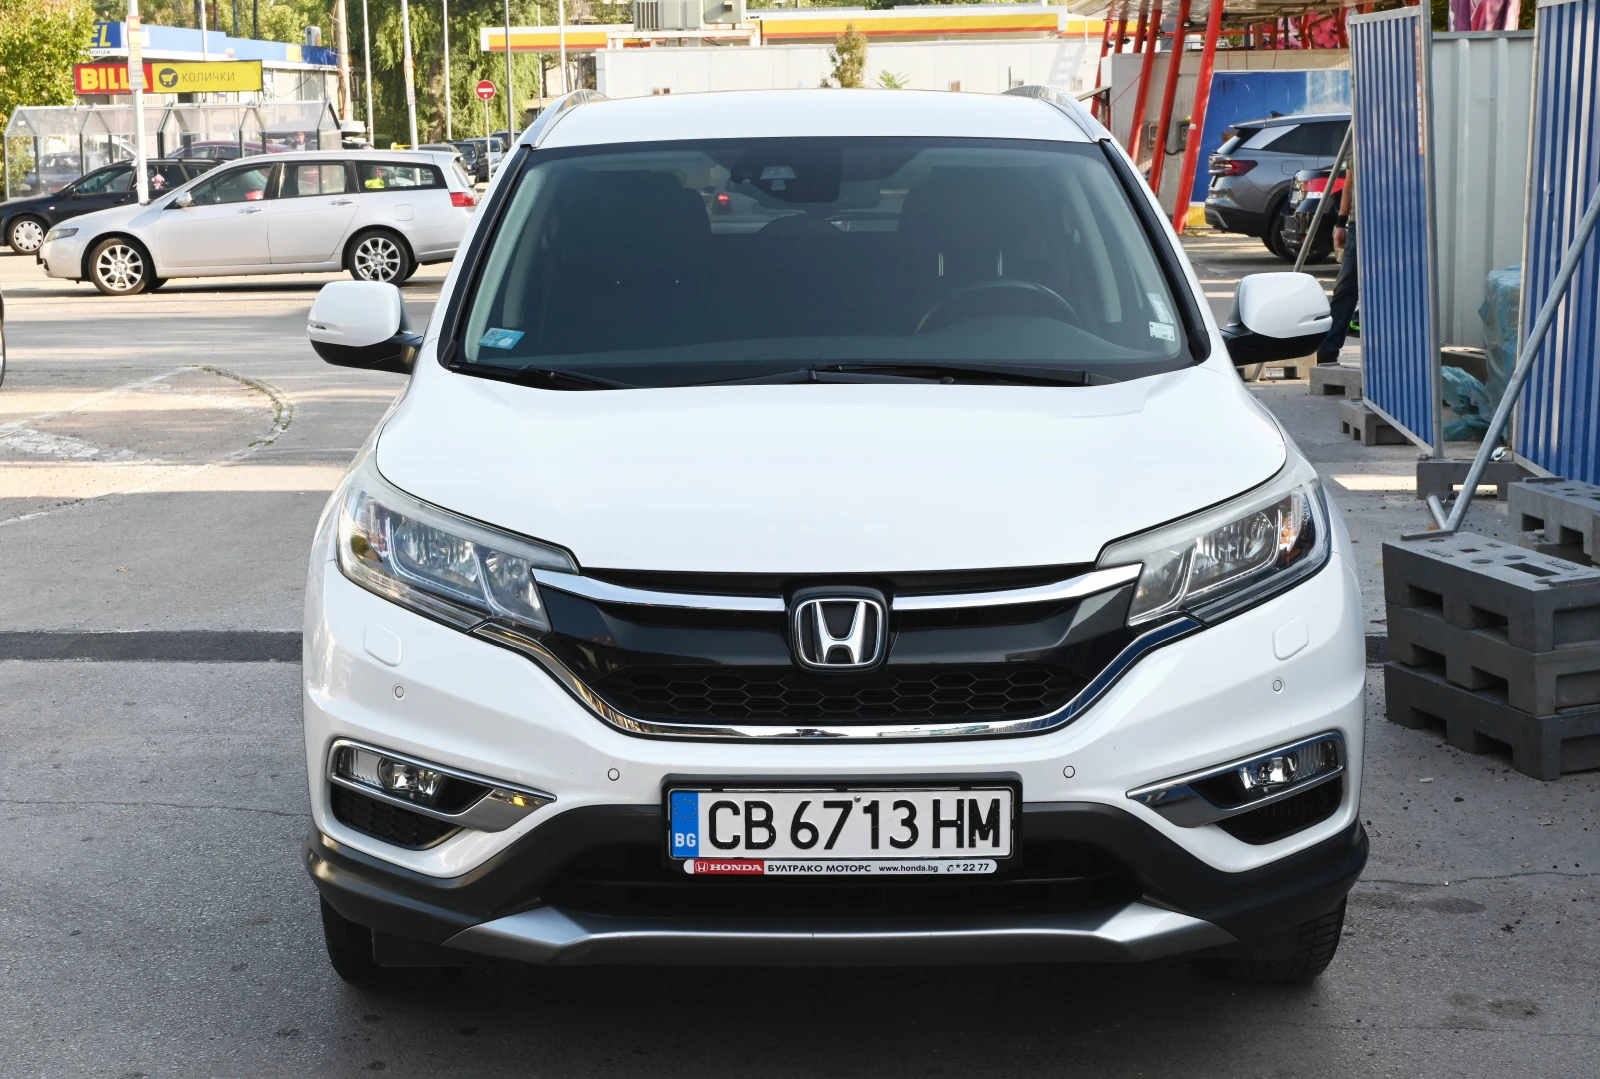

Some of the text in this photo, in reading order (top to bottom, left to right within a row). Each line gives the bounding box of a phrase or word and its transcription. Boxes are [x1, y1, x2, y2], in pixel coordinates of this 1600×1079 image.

[182, 71, 236, 83] КОЛИЧКИ
[708, 798, 1001, 850] CB 6713 HM
[674, 833, 697, 848] BG
[709, 863, 763, 872] HONDA
[767, 864, 872, 873] БУЛТРАКО МОТОРС
[878, 864, 939, 873] www.honda.bg
